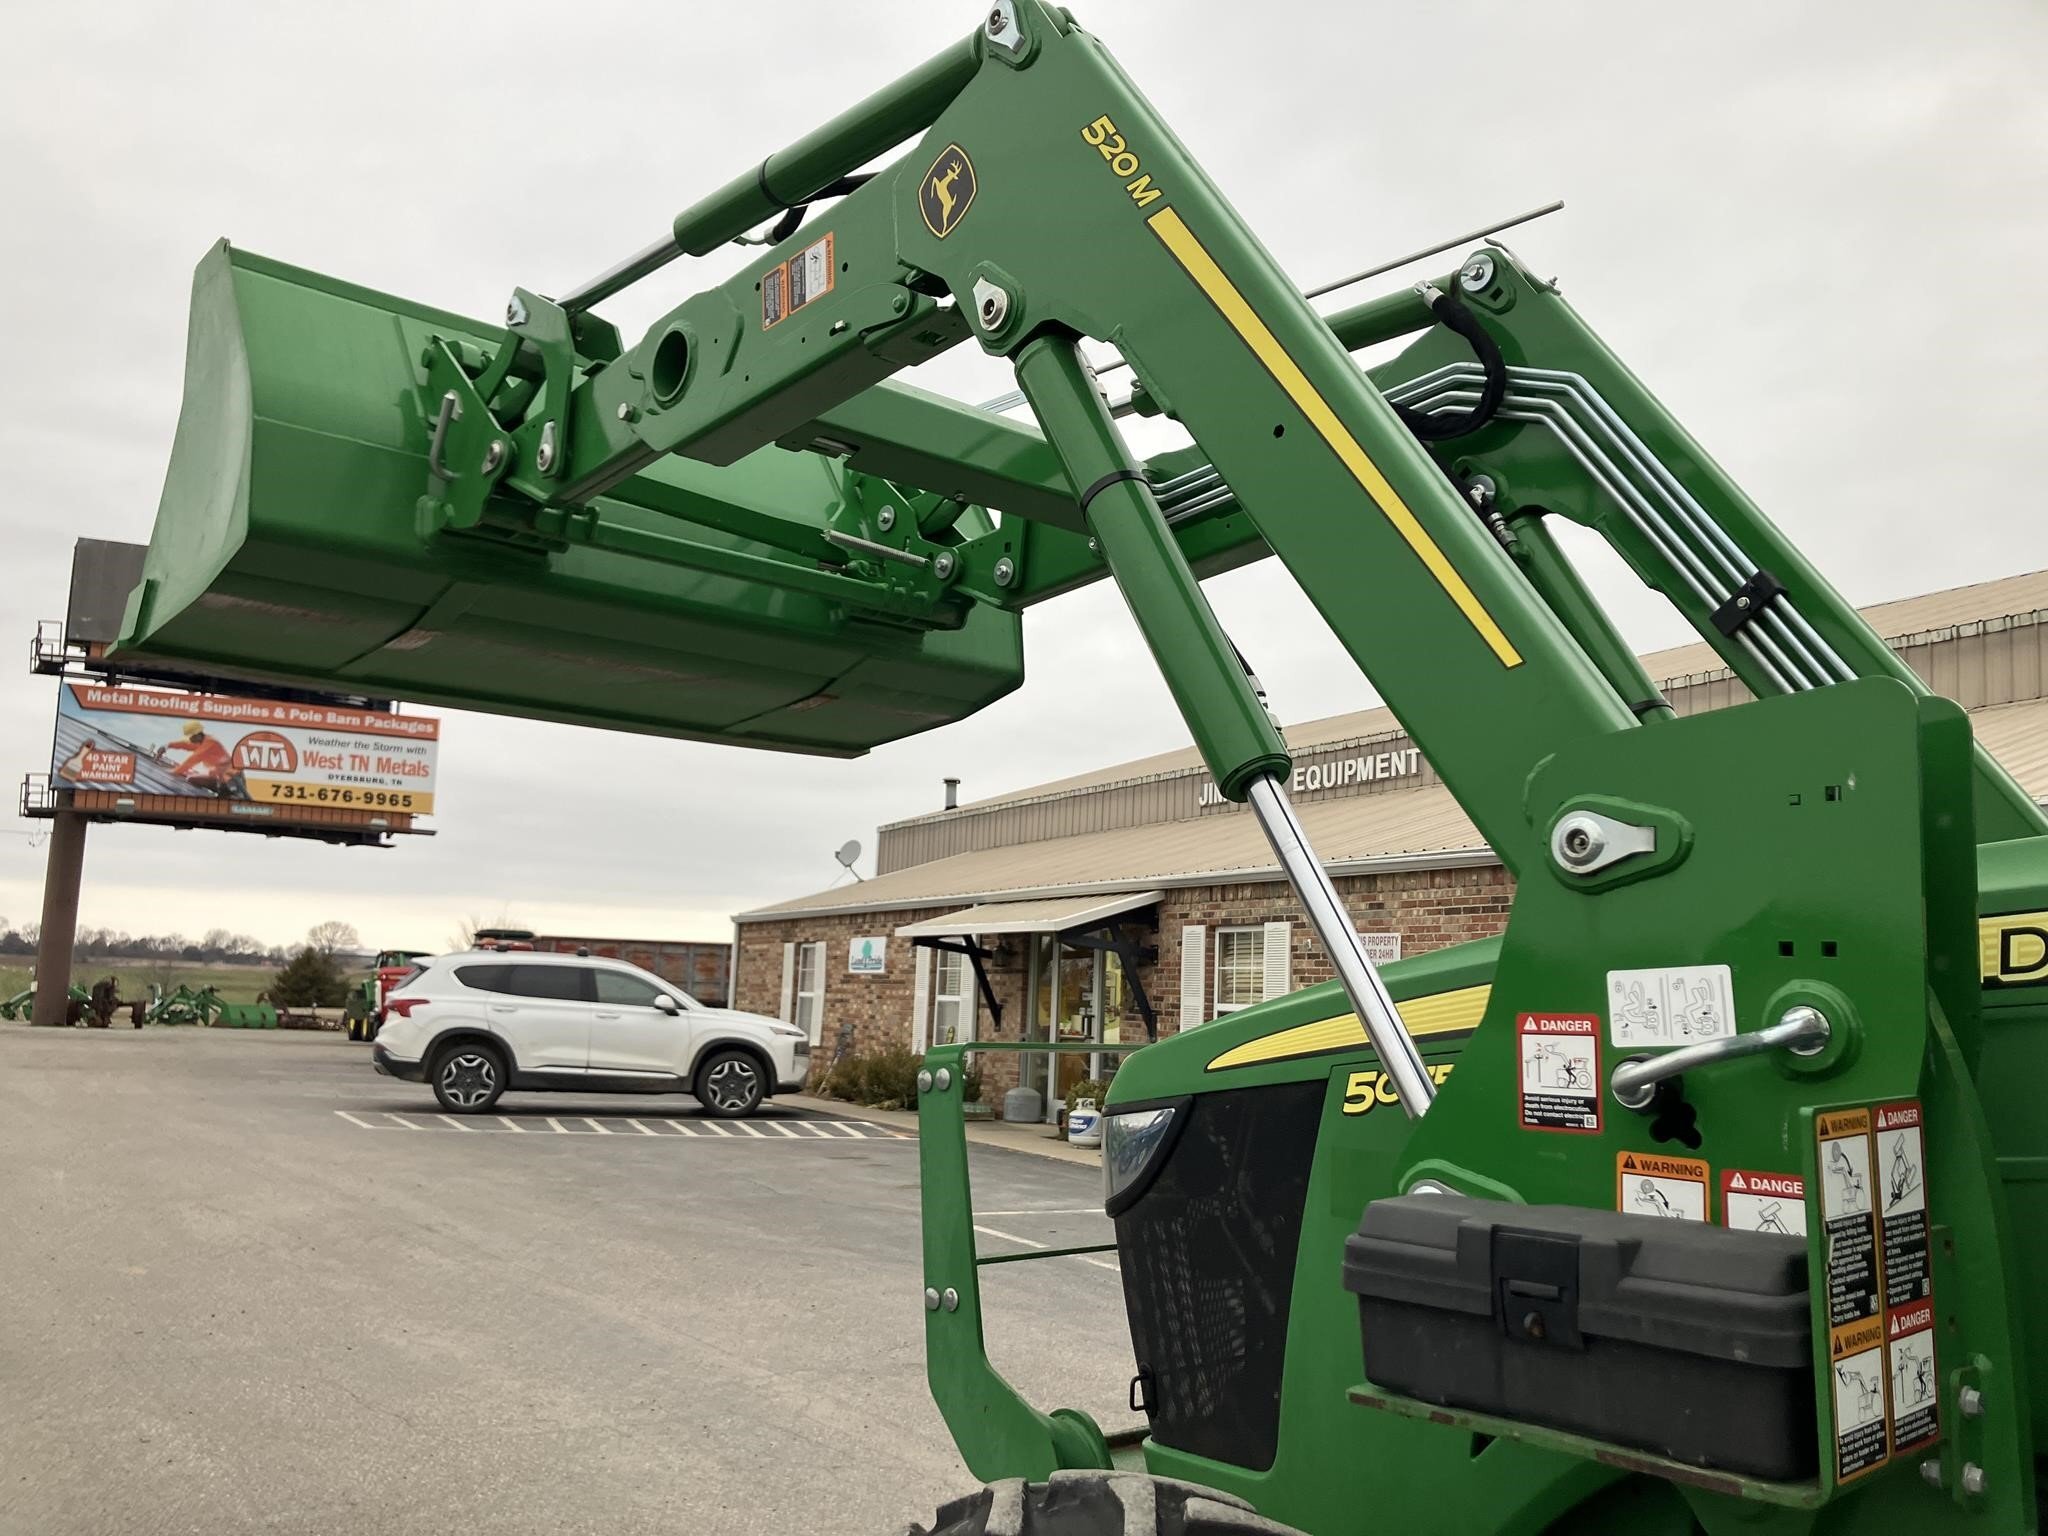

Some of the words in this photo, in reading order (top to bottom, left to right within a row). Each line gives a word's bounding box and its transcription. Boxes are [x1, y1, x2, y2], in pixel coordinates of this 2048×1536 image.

[1081, 114, 1139, 177] 520
[1126, 174, 1163, 208] M
[87, 689, 134, 705] Metal
[138, 694, 200, 713] Roofing
[203, 700, 269, 718] Supplies
[273, 707, 286, 719] &
[289, 708, 323, 722] Pole
[326, 712, 361, 726] Barn
[365, 715, 434, 734] Packages
[308, 736, 351, 749] Weather
[354, 740, 370, 750] the
[373, 741, 403, 753] Storm
[406, 746, 427, 755] with
[86, 753, 99, 762] 40
[102, 754, 129, 764] YEAR
[240, 740, 290, 770] WTM
[303, 750, 344, 770] West
[349, 755, 370, 772] TN
[376, 757, 430, 778] Metals
[81, 770, 131, 781] WARRANTY
[92, 763, 121, 772] PAINT
[1293, 748, 1421, 792] EQUIPMENT
[271, 784, 412, 807] 731-676-9965
[1367, 936, 1399, 946] PROPERTY
[1540, 1020, 1592, 1032] DANGER
[1831, 1115, 1867, 1133] WARNING
[1887, 1109, 1918, 1125] DANGER
[1640, 1159, 1704, 1177] WARNING
[1751, 1177, 1804, 1195] DANGE
[1901, 1309, 1931, 1330] DANGER
[1844, 1326, 1881, 1347] WARNING
